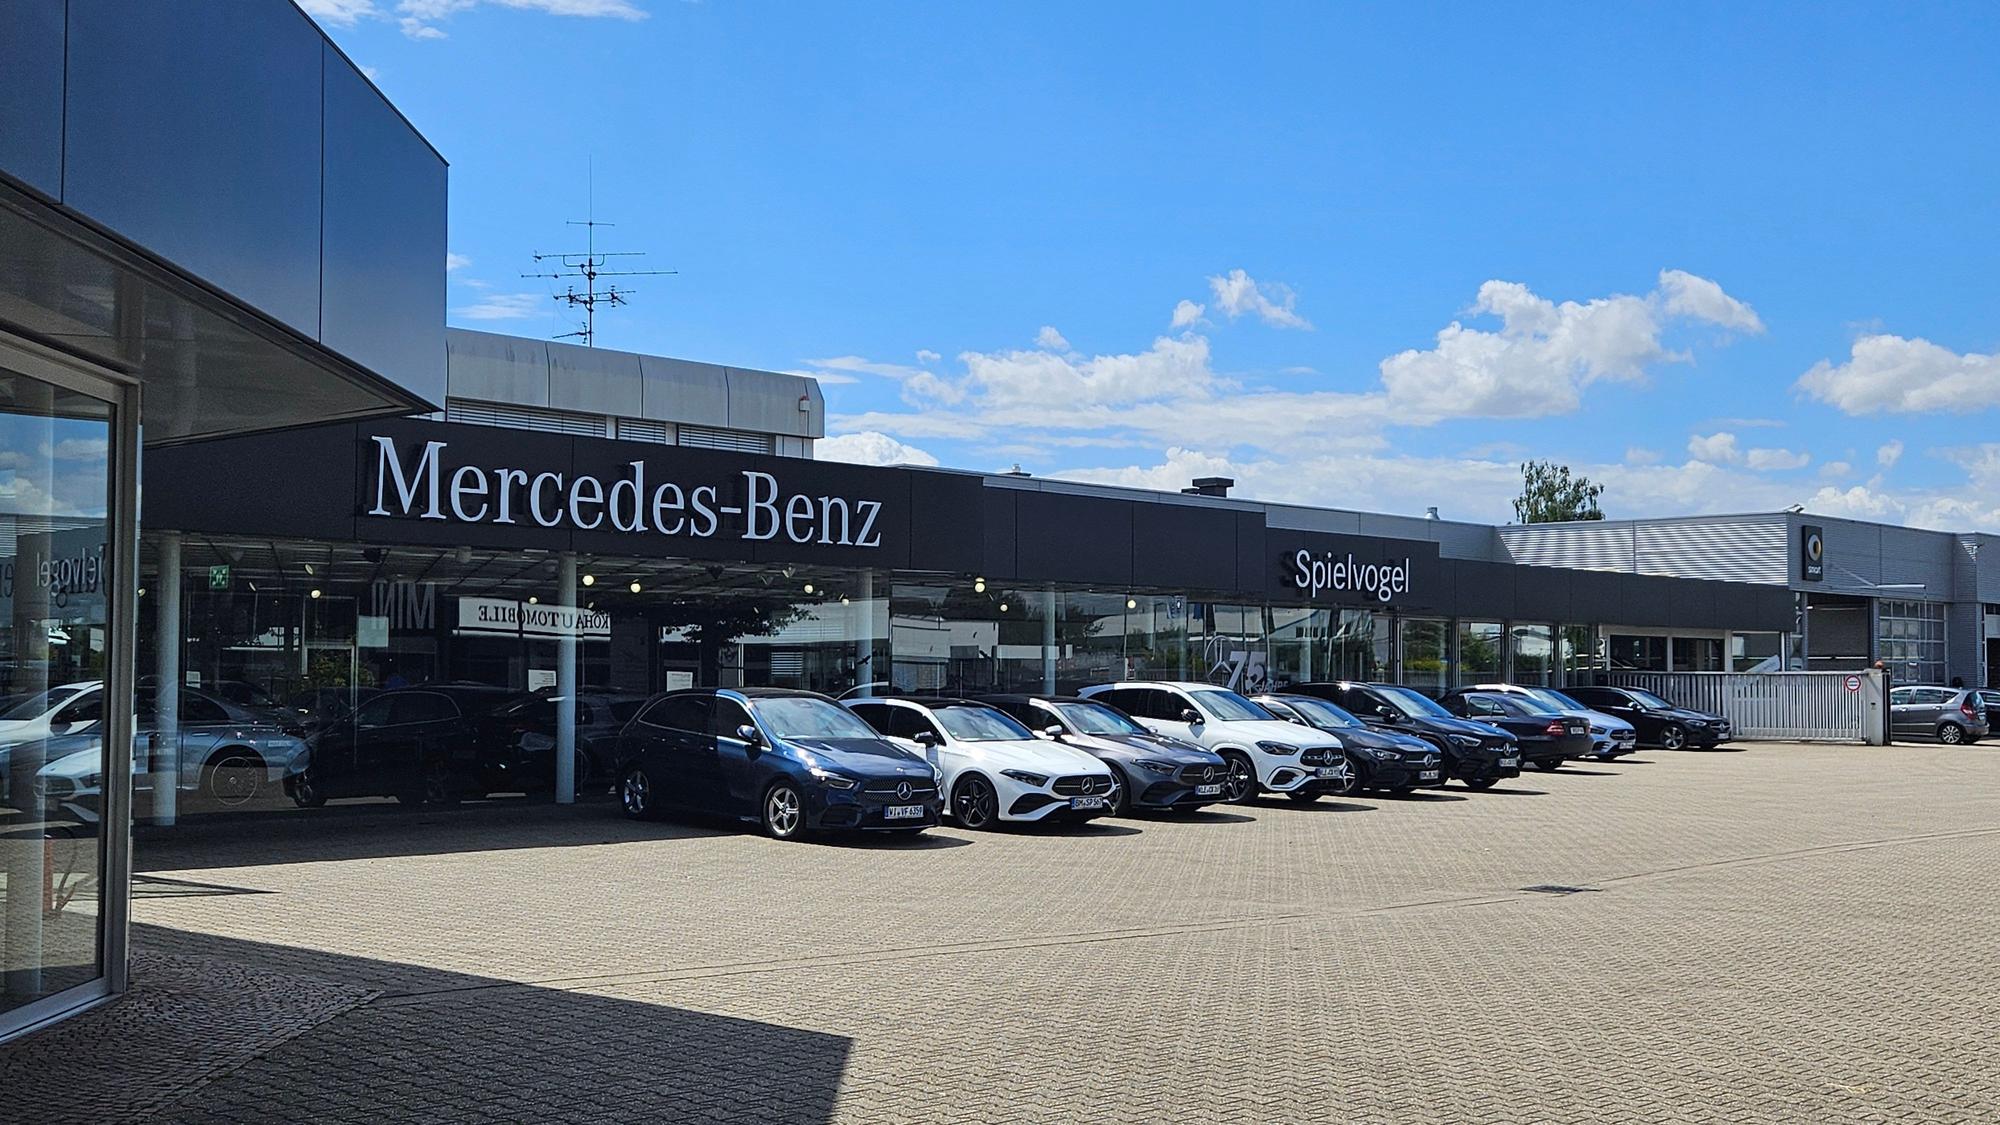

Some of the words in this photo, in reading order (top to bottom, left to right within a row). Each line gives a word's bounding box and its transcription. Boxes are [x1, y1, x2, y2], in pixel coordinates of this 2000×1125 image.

[368, 436, 882, 547] Mercedes-Benz
[1295, 549, 1409, 602] Spielvogel
[1227, 651, 1266, 691] 75
